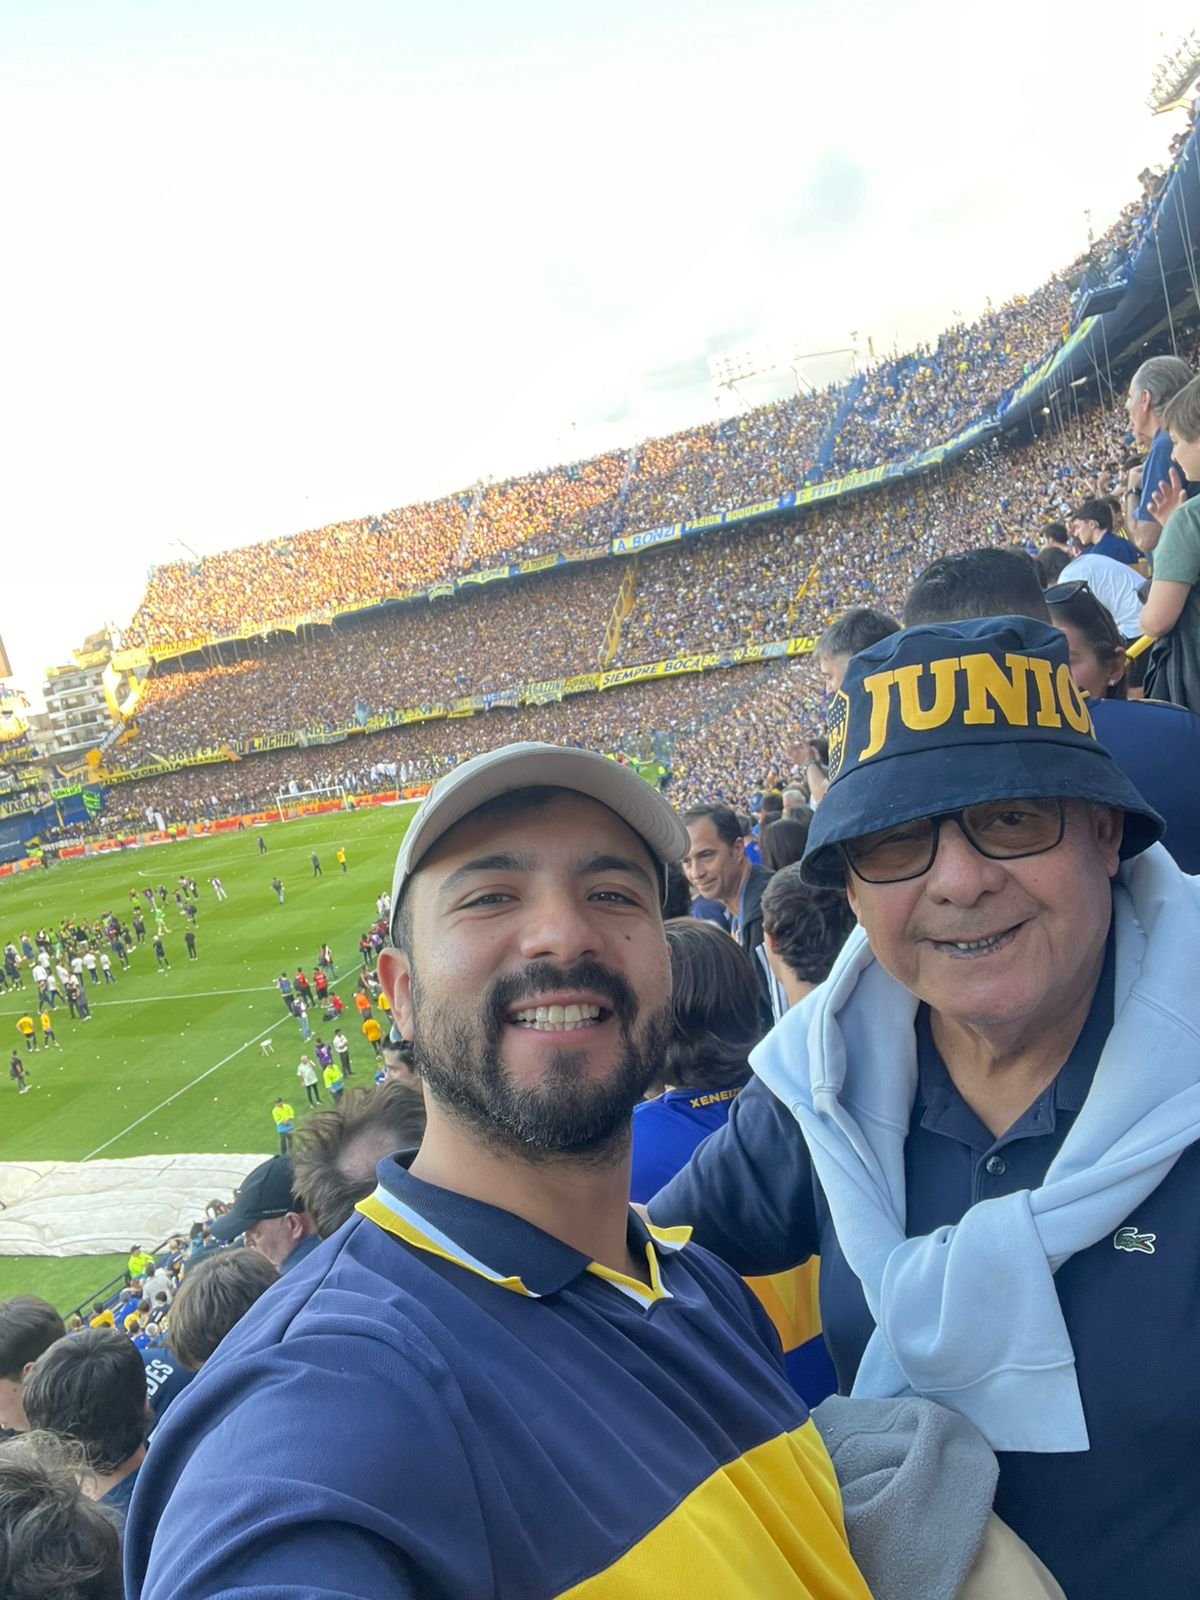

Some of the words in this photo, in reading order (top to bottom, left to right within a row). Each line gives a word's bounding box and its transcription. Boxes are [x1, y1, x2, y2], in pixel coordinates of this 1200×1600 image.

[617, 539, 627, 552] A
[632, 523, 676, 549] BONZI
[602, 664, 658, 686] SIEMPRE
[664, 656, 701, 673] BOCA
[858, 652, 1097, 761] JUNIO
